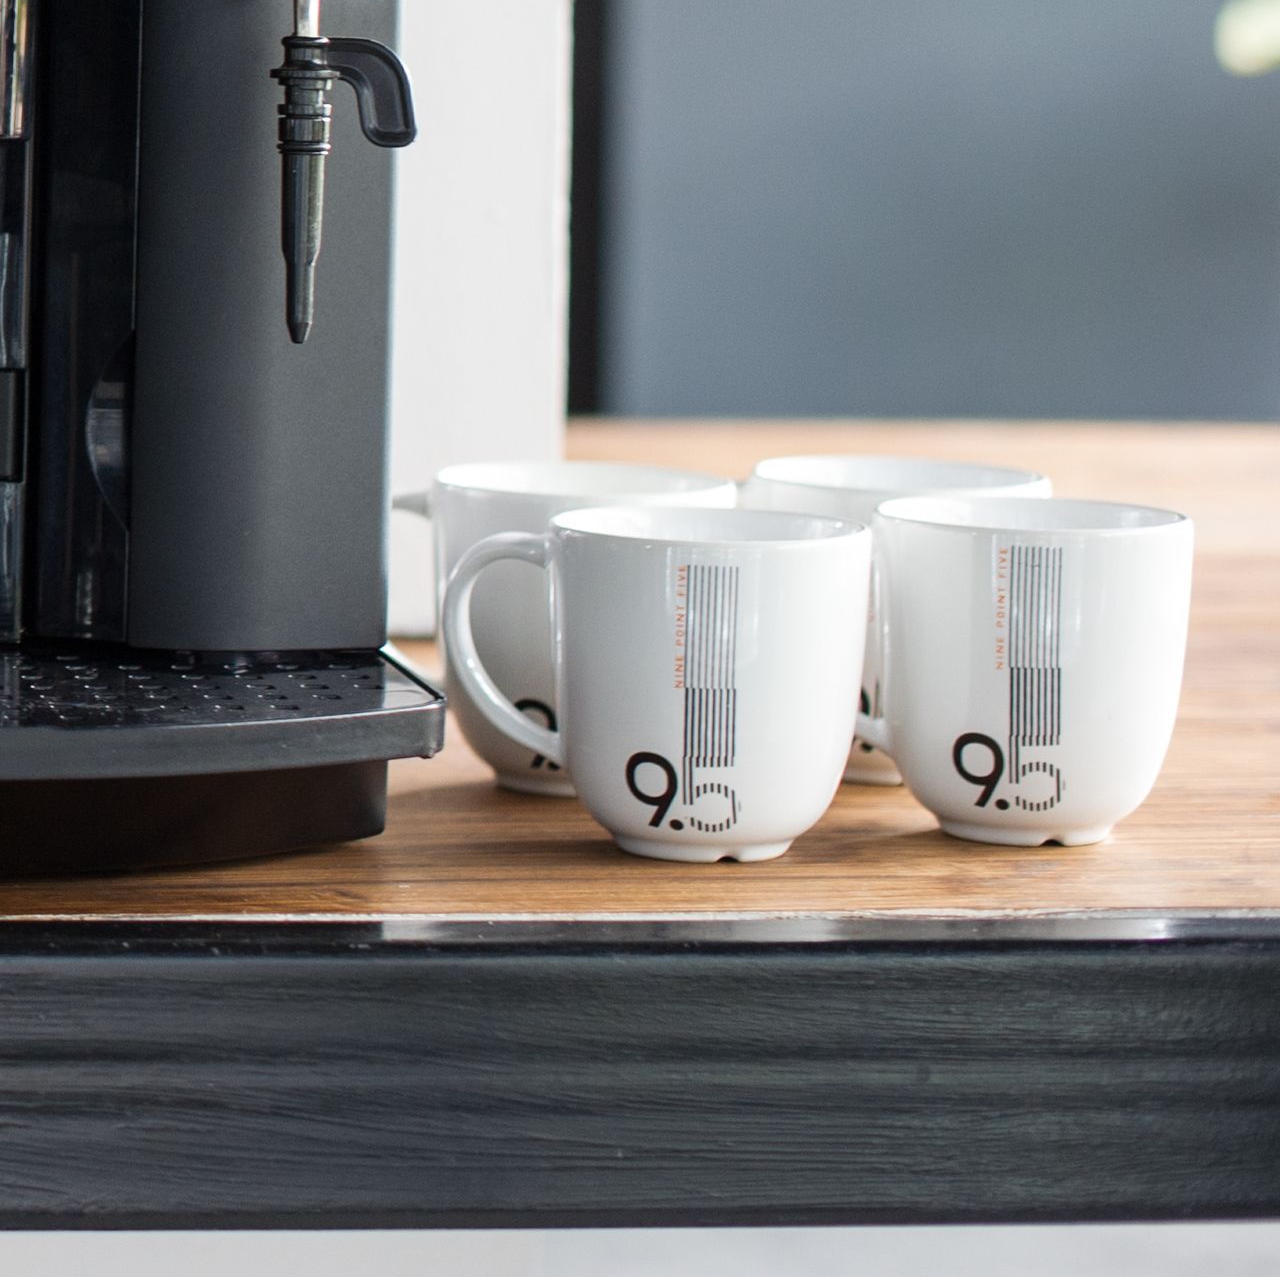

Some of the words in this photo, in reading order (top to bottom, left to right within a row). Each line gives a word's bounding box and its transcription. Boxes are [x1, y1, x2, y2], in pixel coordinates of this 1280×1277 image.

[677, 564, 687, 597] FIVE
[998, 547, 1008, 578] FIVE
[996, 587, 1006, 627] POINT
[675, 606, 685, 646] POINT
[995, 638, 1005, 670] NINE
[673, 656, 685, 689] NINE
[952, 732, 1061, 811] 9.5
[625, 751, 737, 832] 9.5
